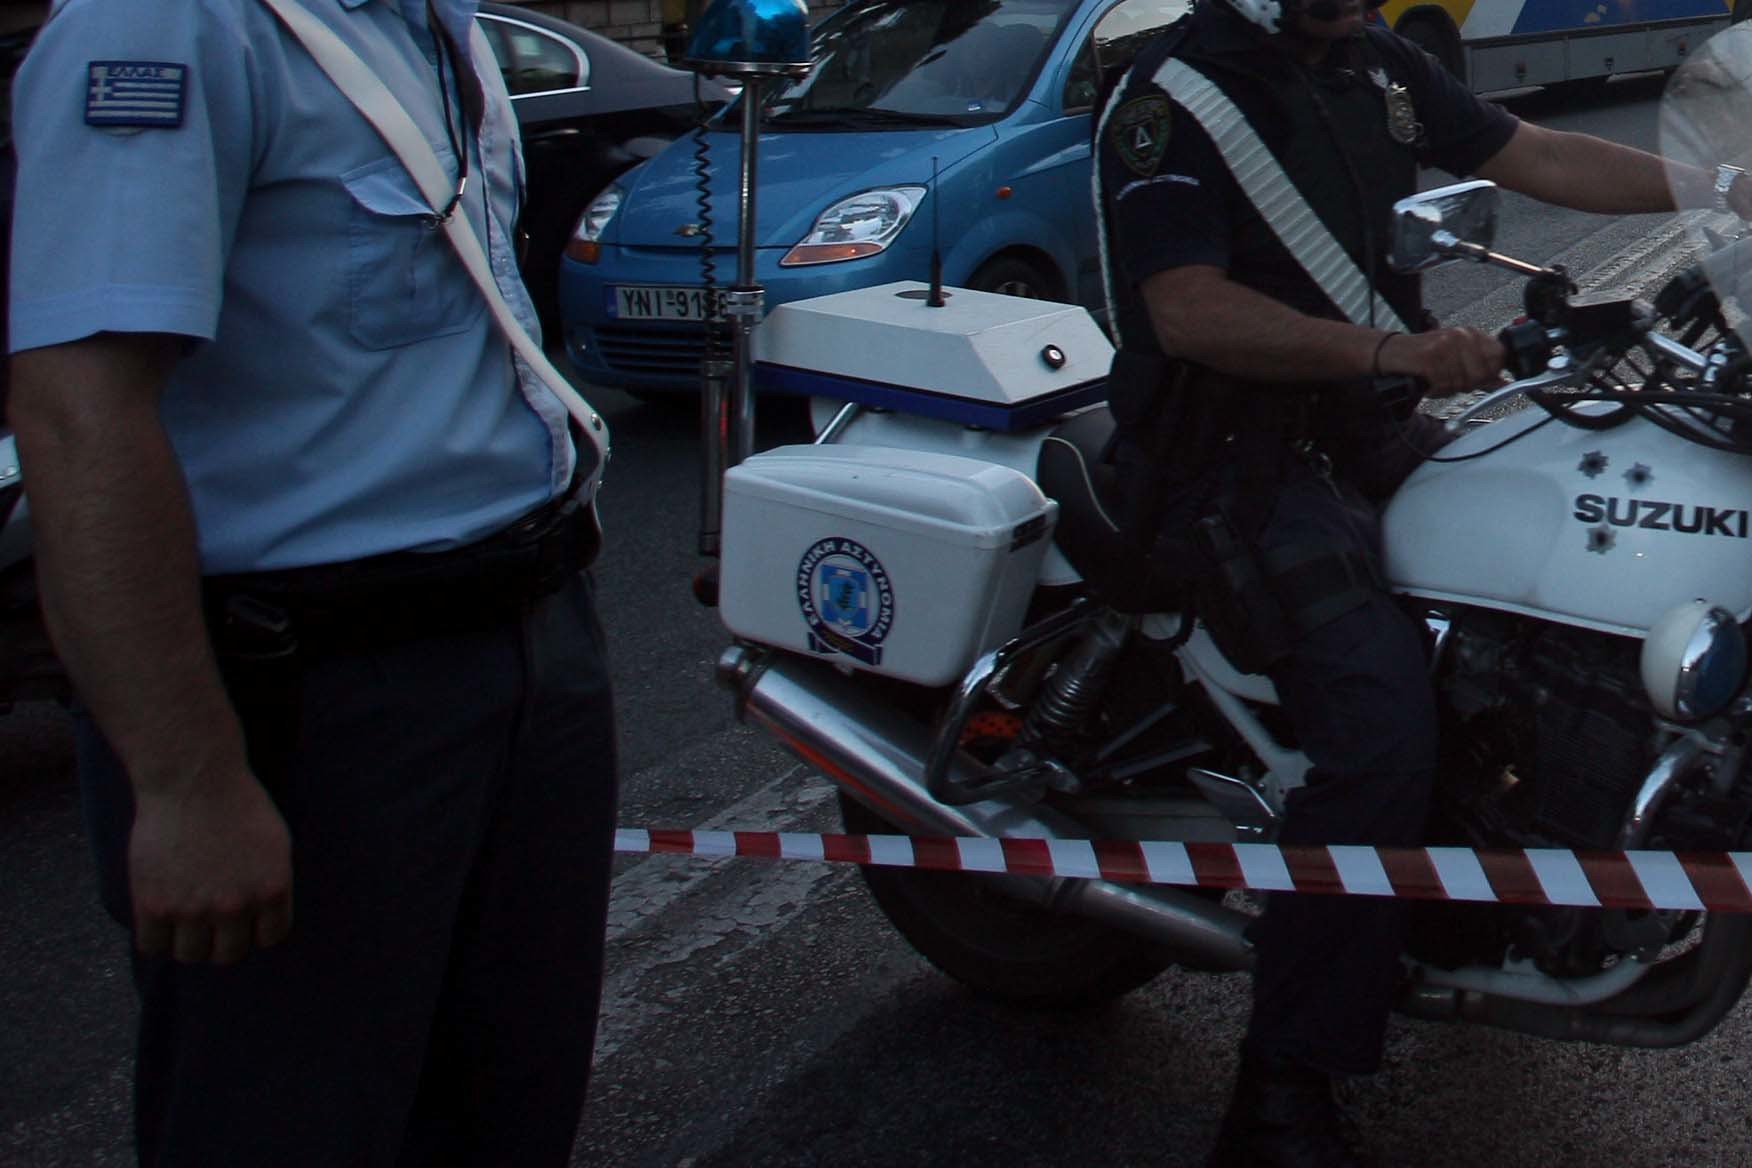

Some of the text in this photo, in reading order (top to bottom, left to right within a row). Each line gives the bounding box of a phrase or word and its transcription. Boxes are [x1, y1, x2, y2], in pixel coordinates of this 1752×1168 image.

[1573, 493, 1749, 538] SUZUKI
[799, 541, 892, 638] ΕΛΛΗΝΙΚΗ ΑΣΤΥΝΟΜΙΑ
